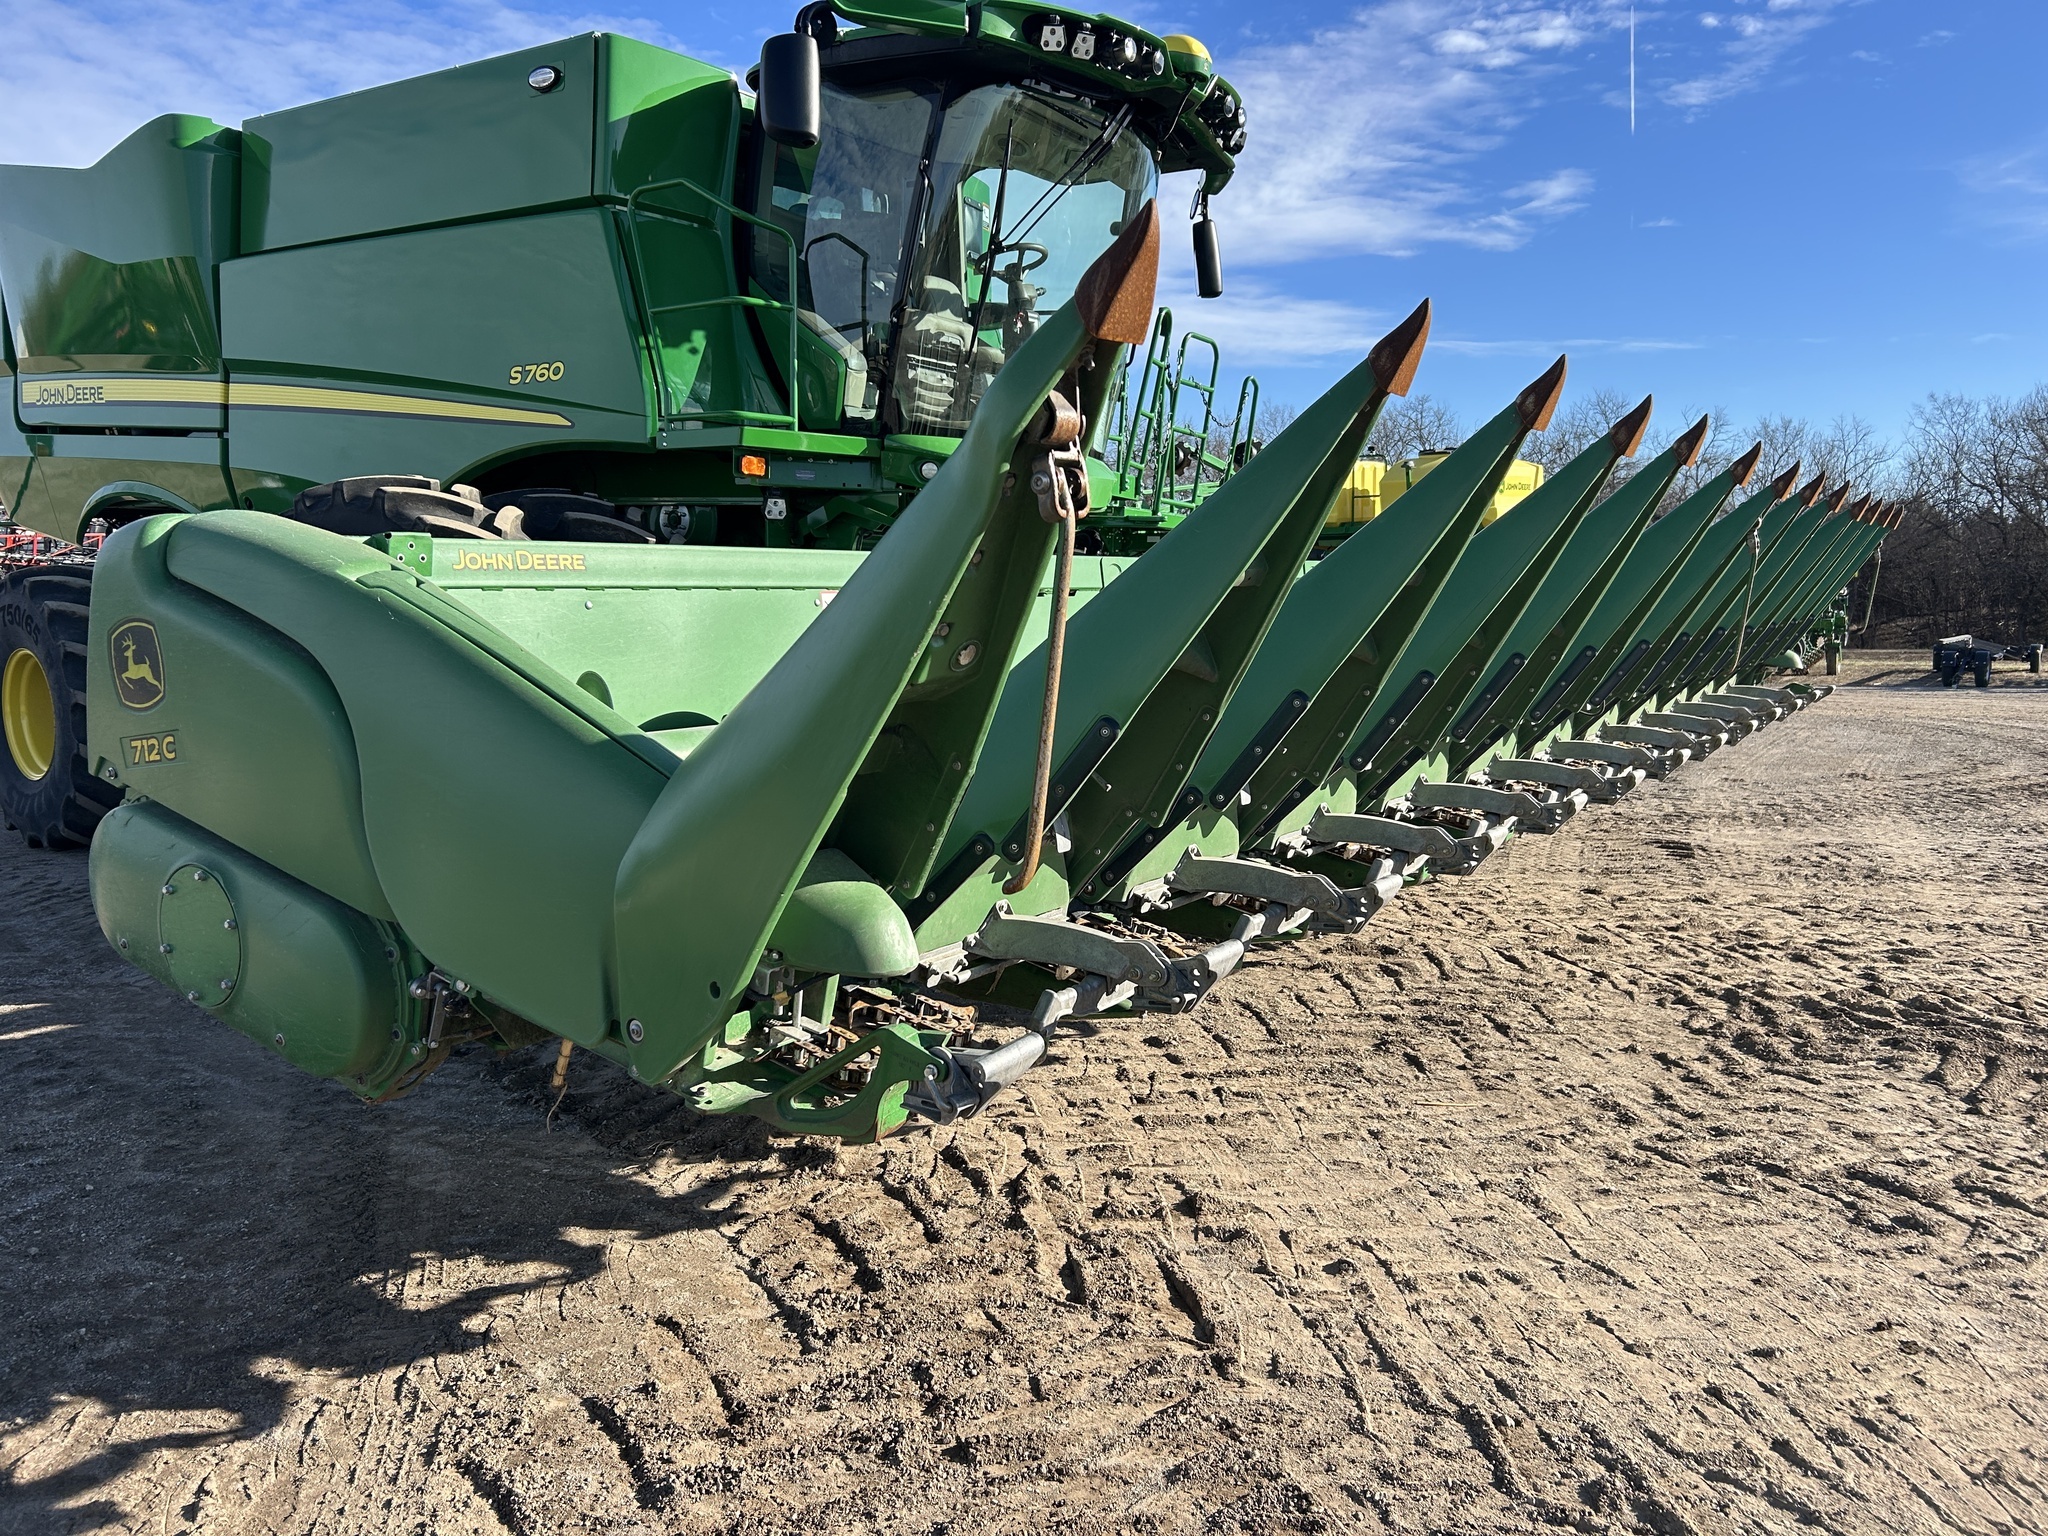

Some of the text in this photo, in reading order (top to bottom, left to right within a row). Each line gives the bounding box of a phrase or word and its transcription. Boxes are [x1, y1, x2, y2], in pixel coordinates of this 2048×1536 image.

[509, 361, 565, 385] S760
[36, 384, 105, 404] JOHN DEERE
[453, 549, 586, 571] JOHN DEERE
[0, 603, 41, 646] 750/65
[130, 734, 176, 764] 712C
